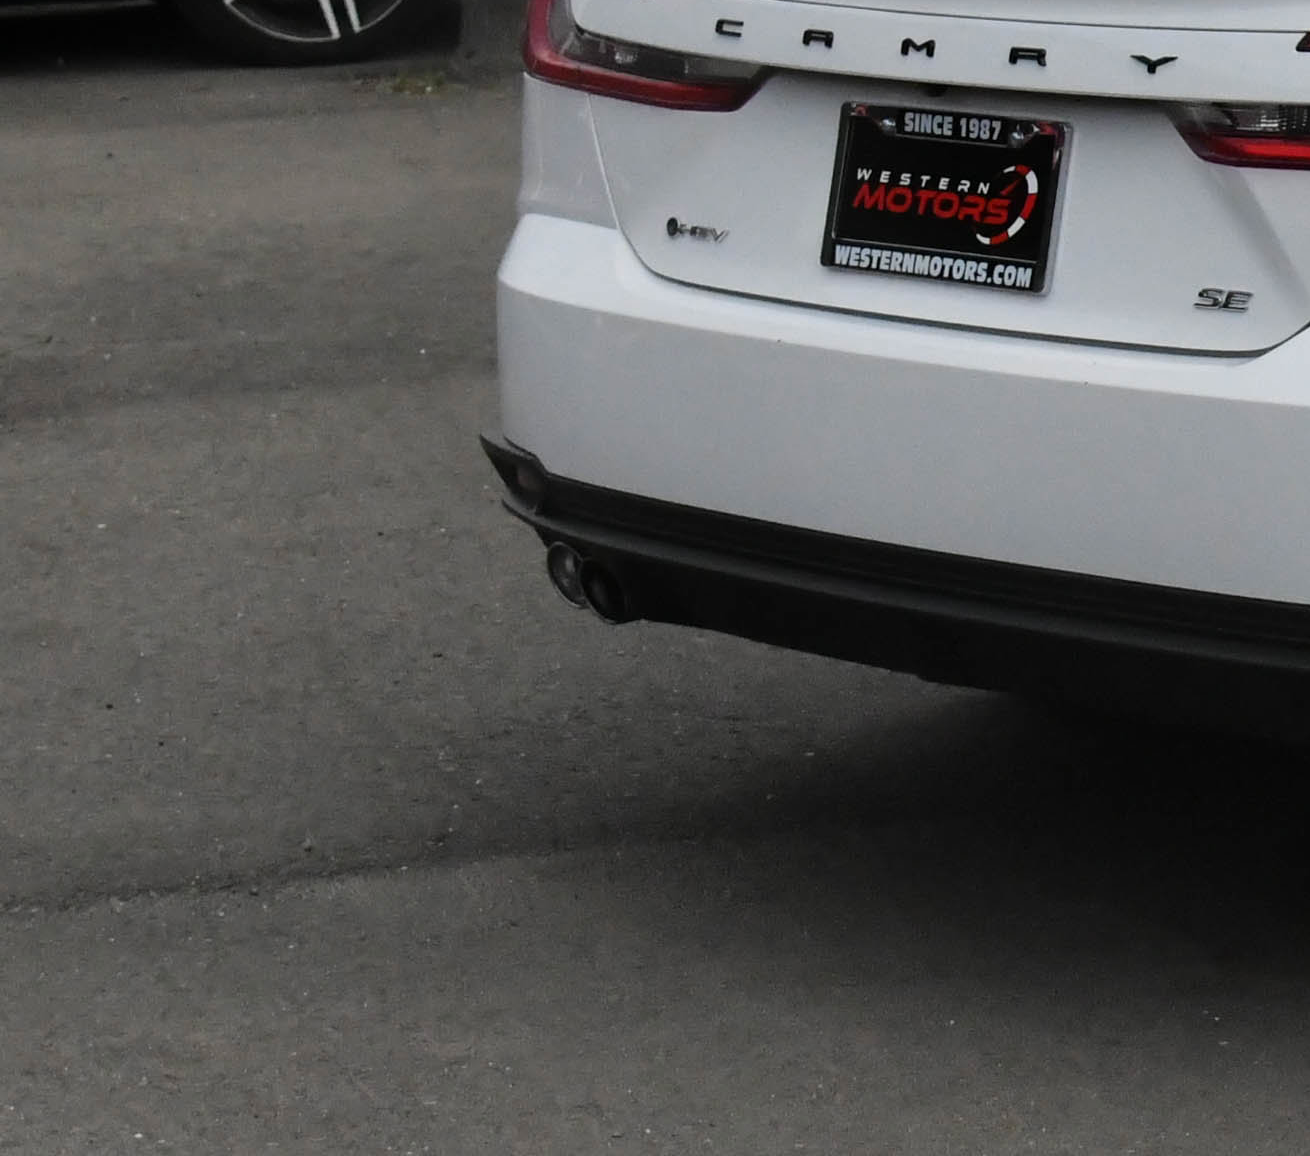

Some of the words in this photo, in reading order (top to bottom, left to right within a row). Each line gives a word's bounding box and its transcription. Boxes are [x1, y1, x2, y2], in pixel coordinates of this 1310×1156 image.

[715, 18, 1179, 75] CAMRY
[903, 112, 954, 137] SINCE
[959, 117, 1002, 141] 1987
[856, 167, 991, 195] WESTERN
[852, 182, 1012, 226] MOTORS
[834, 244, 1034, 289] WESTERNMOTORS.COM
[1193, 288, 1254, 313] SE
